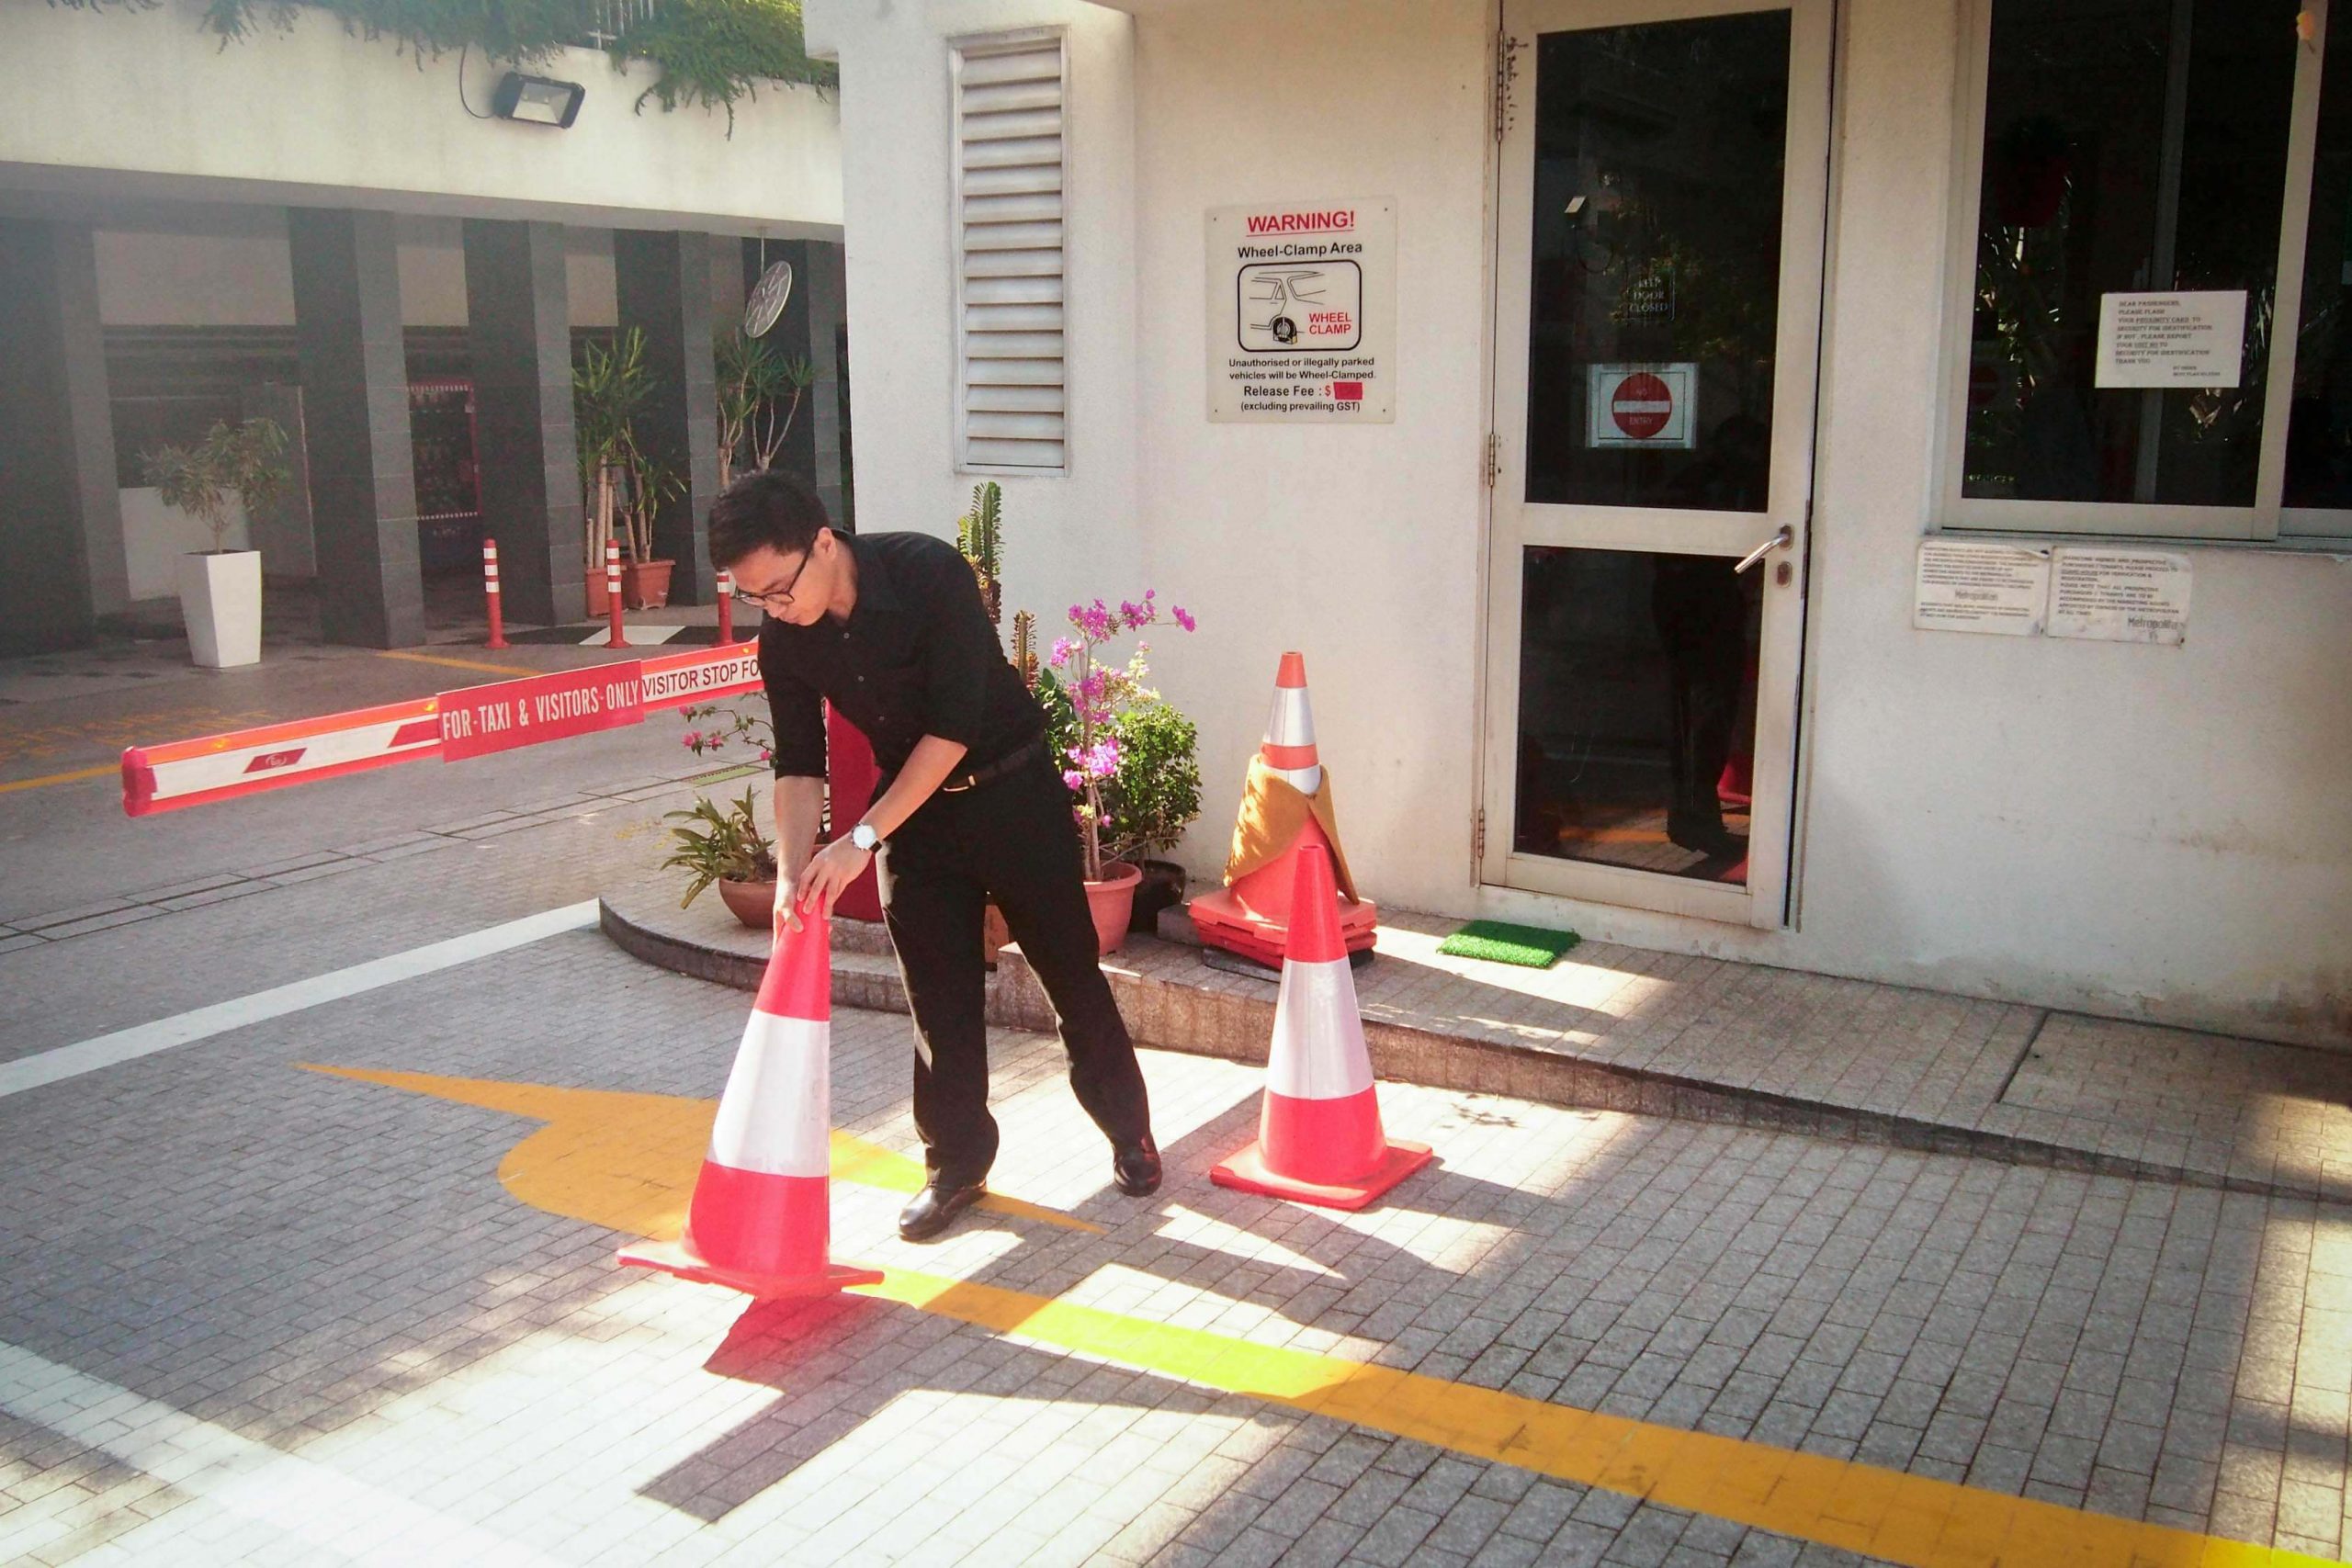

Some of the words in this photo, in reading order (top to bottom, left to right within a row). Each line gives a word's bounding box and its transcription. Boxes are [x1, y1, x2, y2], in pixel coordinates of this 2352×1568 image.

[1248, 210, 1355, 232] WARNING!
[1238, 243, 1327, 258] Wheel-Clamp
[1330, 242, 1363, 254] Area
[1634, 290, 1665, 300] DOOR
[1629, 302, 1668, 312] CLOSED
[1309, 312, 1352, 322] WHEEL
[1309, 323, 1351, 335] CLAMP
[1229, 358, 1290, 367] Unauthorised
[1304, 357, 1340, 368] illegally
[1341, 356, 1374, 368] parked
[1229, 371, 1267, 380] vehicles
[1269, 371, 1284, 379] will
[1286, 371, 1297, 379] be
[1299, 370, 1376, 380] Wheel-Clamped.
[1244, 386, 1290, 397] Release
[1293, 386, 1315, 397] Fee
[1324, 385, 1332, 398] $
[1635, 388, 1648, 397] NO
[1240, 401, 1287, 412] (excluding
[1289, 401, 1335, 412] prevailing
[1336, 401, 1361, 412] GST)
[1629, 416, 1654, 426] ENTRY
[642, 670, 698, 696] VISITOR
[703, 662, 738, 685] STOP
[442, 709, 472, 740] FOR
[478, 702, 511, 733] TAXI
[518, 698, 529, 727] &
[536, 686, 599, 723] VISITORS
[606, 680, 639, 710] ONLY
